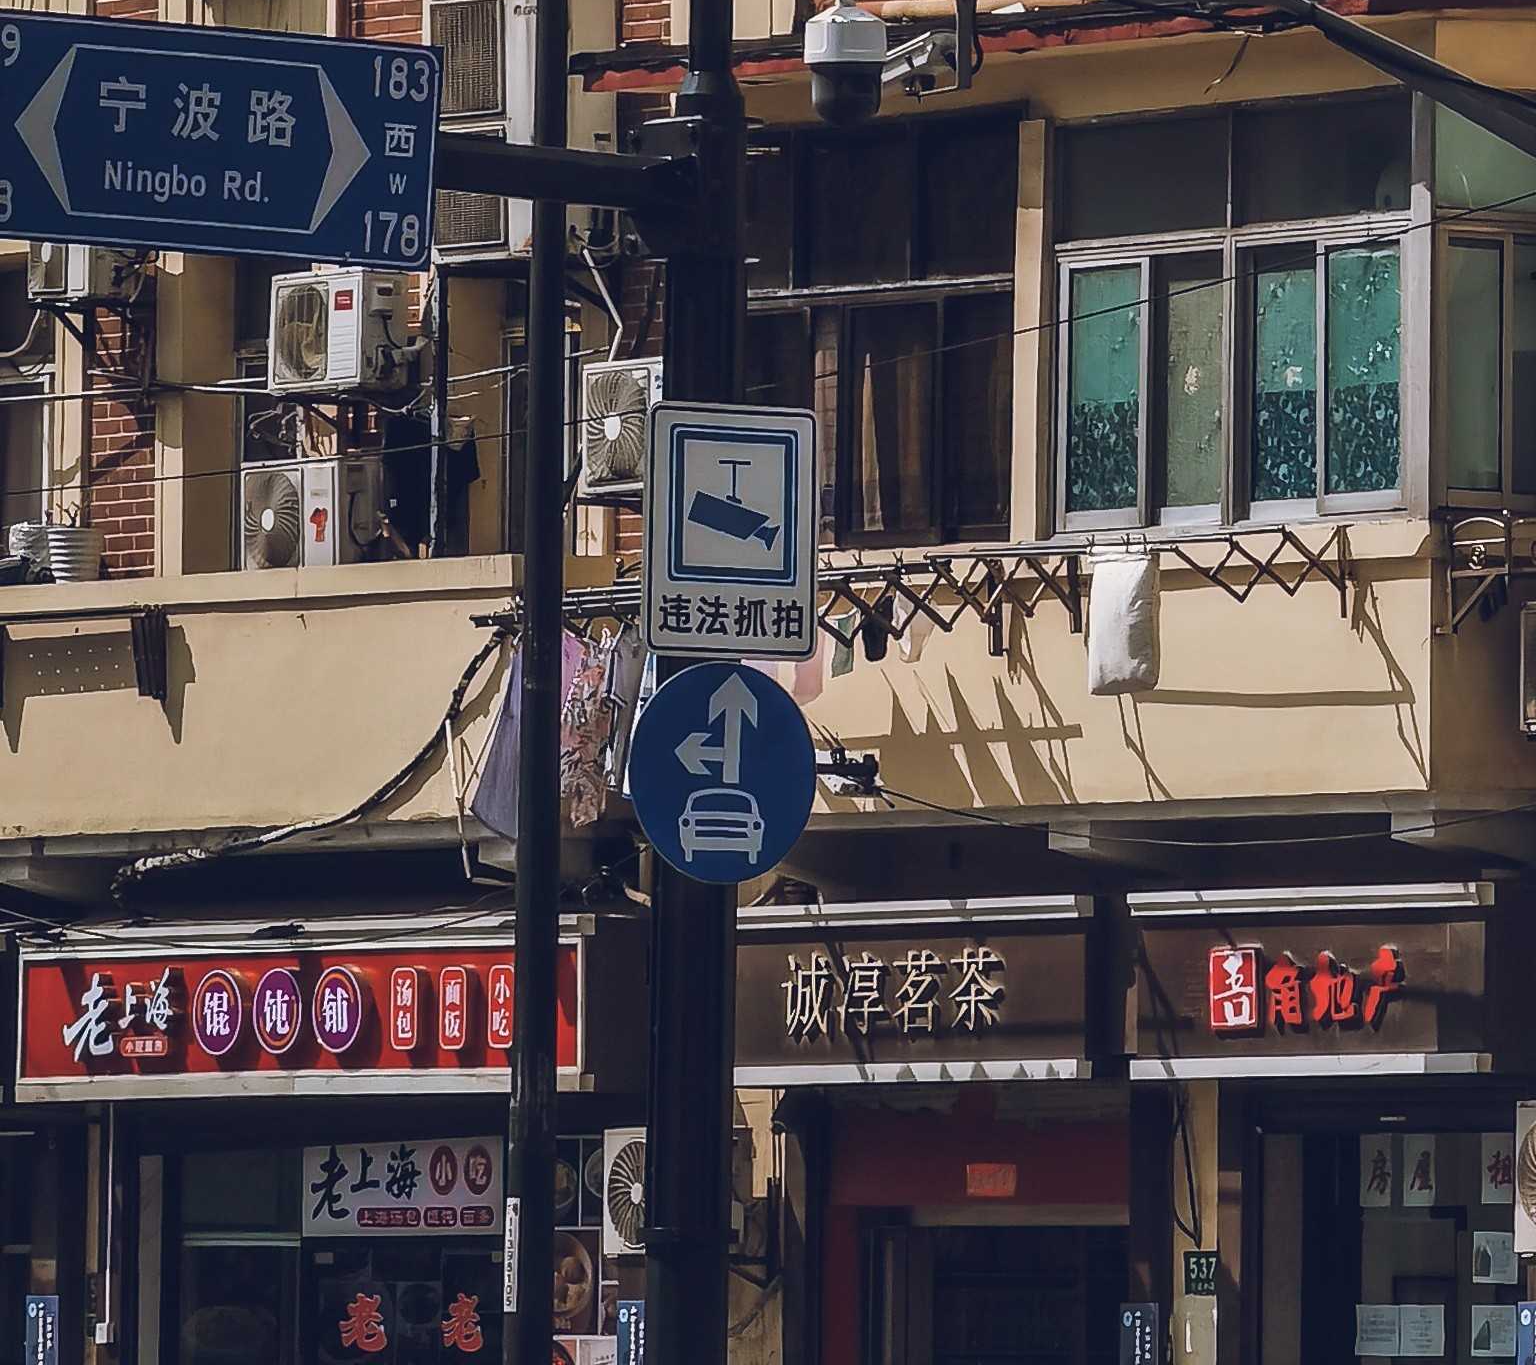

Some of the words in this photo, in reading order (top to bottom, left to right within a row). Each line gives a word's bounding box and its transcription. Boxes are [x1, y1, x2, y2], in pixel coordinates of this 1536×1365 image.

[374, 55, 430, 102] 183
[100, 76, 297, 147] 宁波路
[384, 122, 418, 158] 西
[104, 160, 206, 203] Ningbo
[223, 170, 270, 203] Rd.
[389, 173, 407, 195] W
[364, 210, 419, 257] 178
[658, 594, 804, 640] 违法抓拍
[492, 974, 511, 1037] 小吃
[781, 947, 1002, 1037] 诚淳茗茶
[1189, 1257, 1217, 1279] 537
